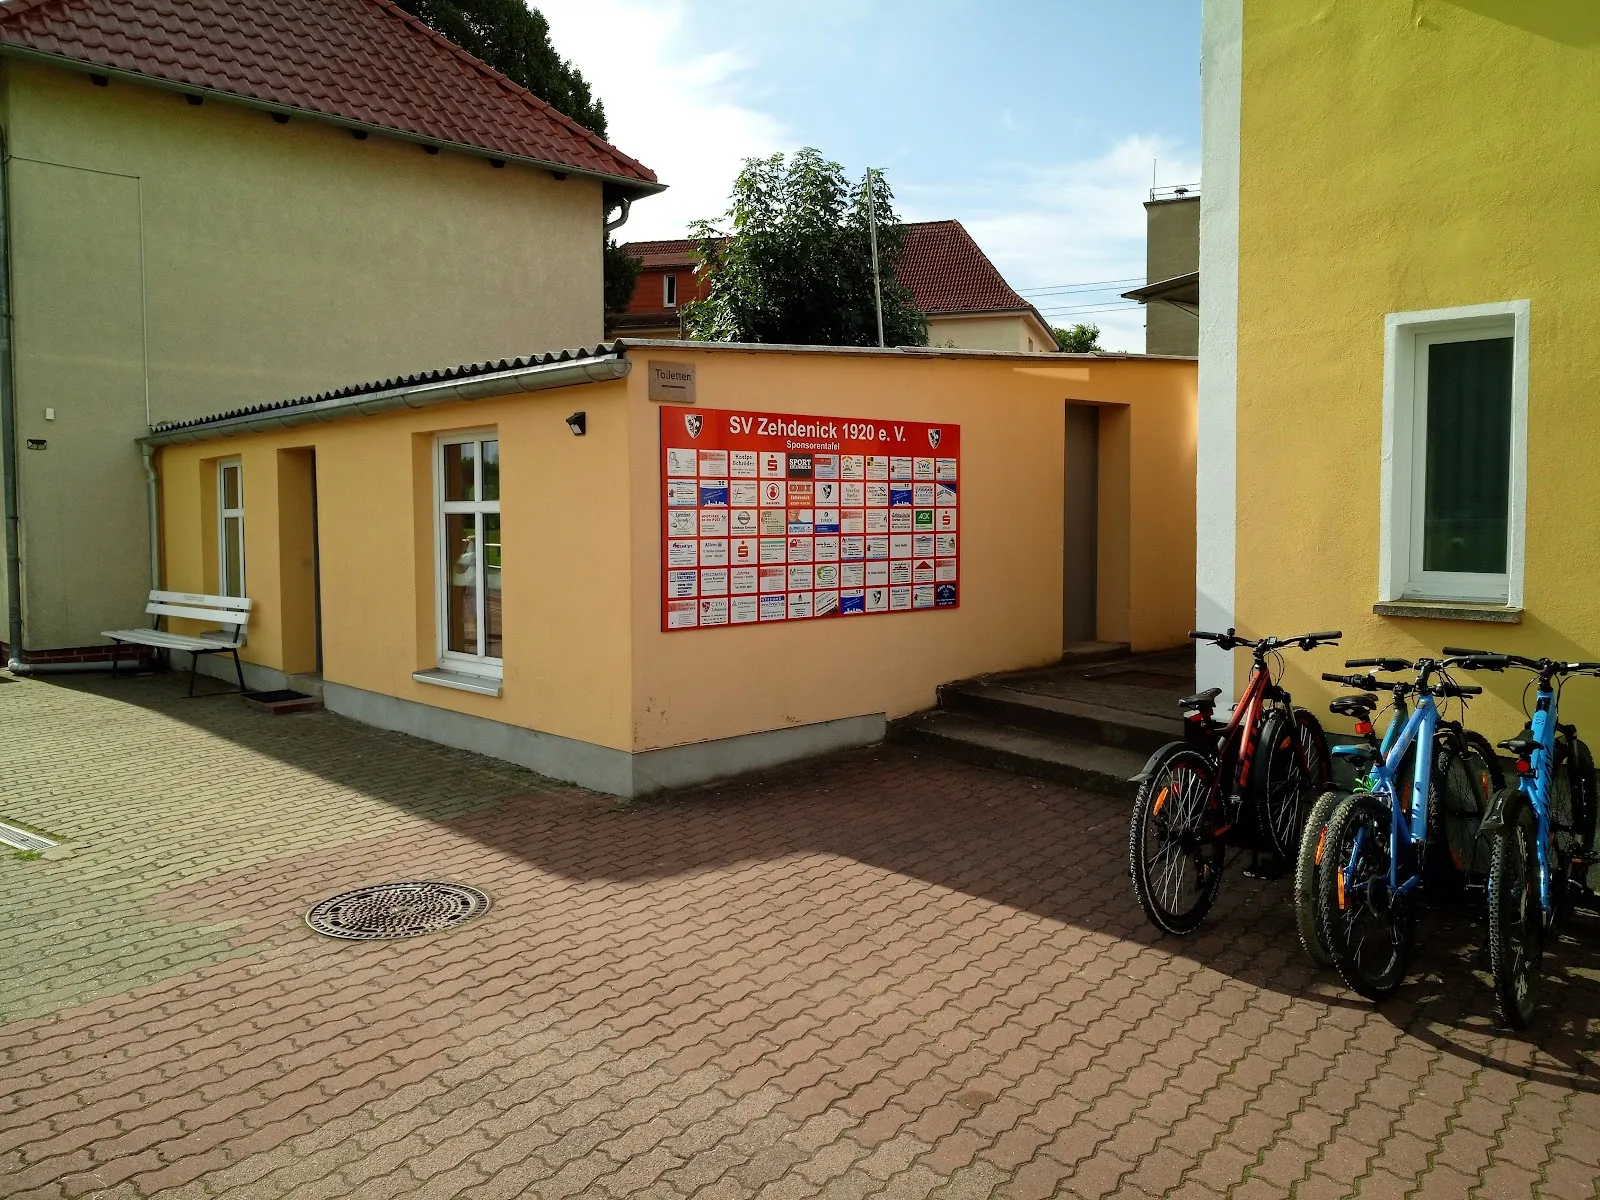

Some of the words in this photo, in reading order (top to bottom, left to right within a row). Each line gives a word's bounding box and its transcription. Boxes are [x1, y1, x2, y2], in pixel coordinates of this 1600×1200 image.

[655, 368, 692, 382] Toiletten
[729, 415, 753, 435] SV
[757, 417, 838, 439] Zehdenick
[842, 423, 875, 441] 1920
[878, 431, 890, 441] e.
[894, 426, 907, 442] V.
[786, 440, 840, 451] Sponsorentafel
[789, 458, 812, 466] SPORT
[918, 512, 931, 520] AOK
